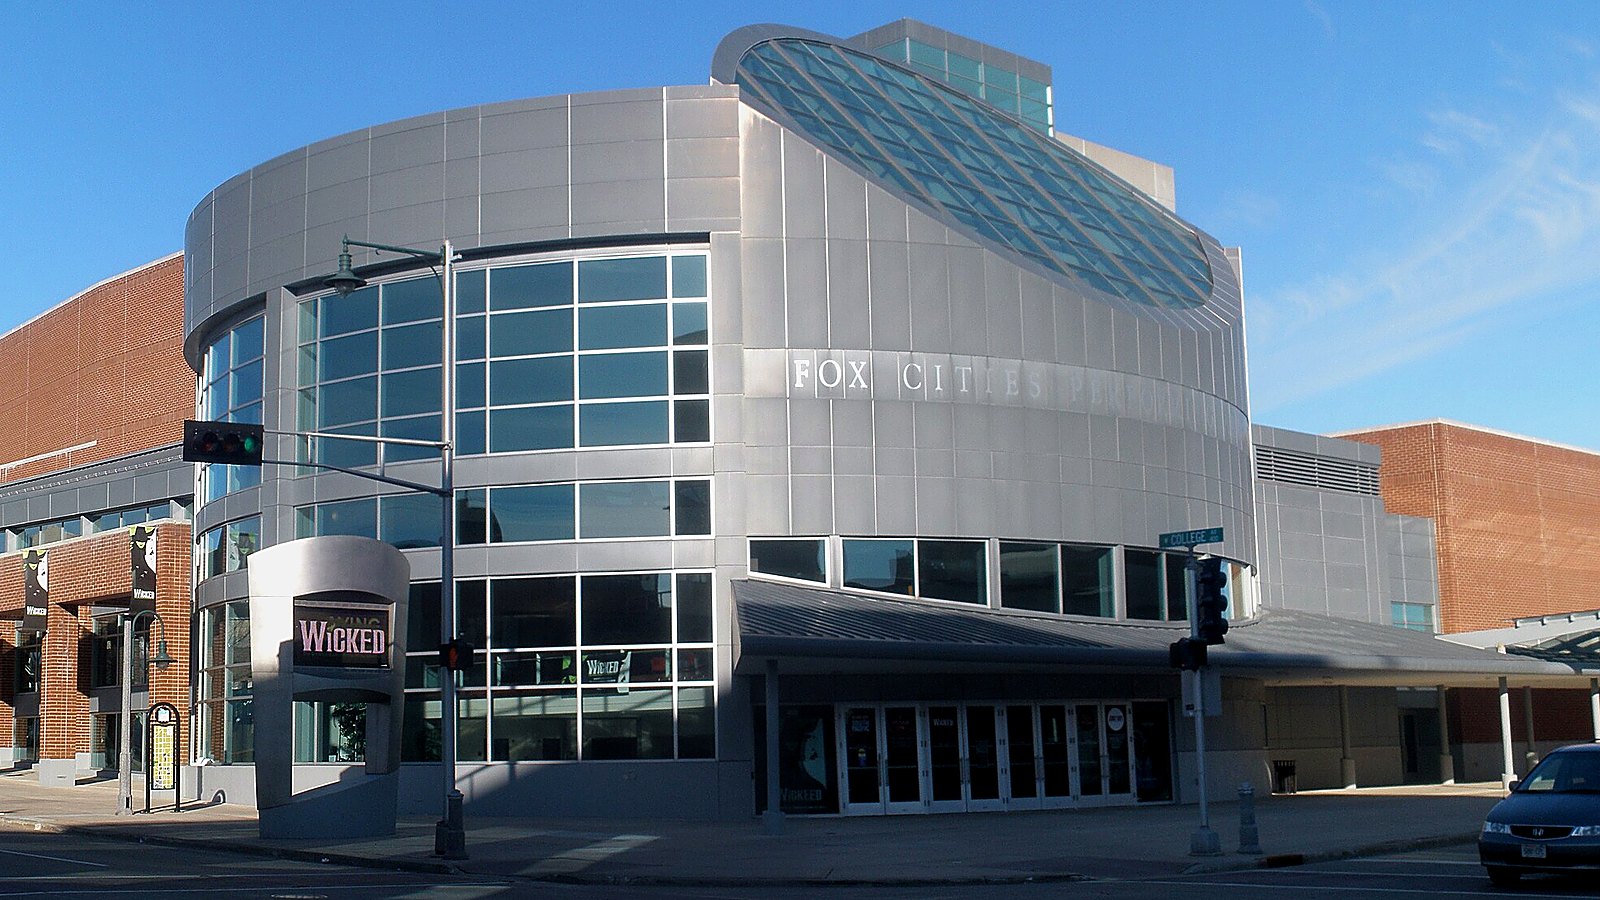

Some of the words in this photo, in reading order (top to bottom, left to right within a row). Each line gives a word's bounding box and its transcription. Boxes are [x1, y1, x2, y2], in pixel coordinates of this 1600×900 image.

[794, 359, 868, 389] FOX
[902, 362, 1042, 399] CITIES
[1171, 531, 1206, 545] COLLEGE
